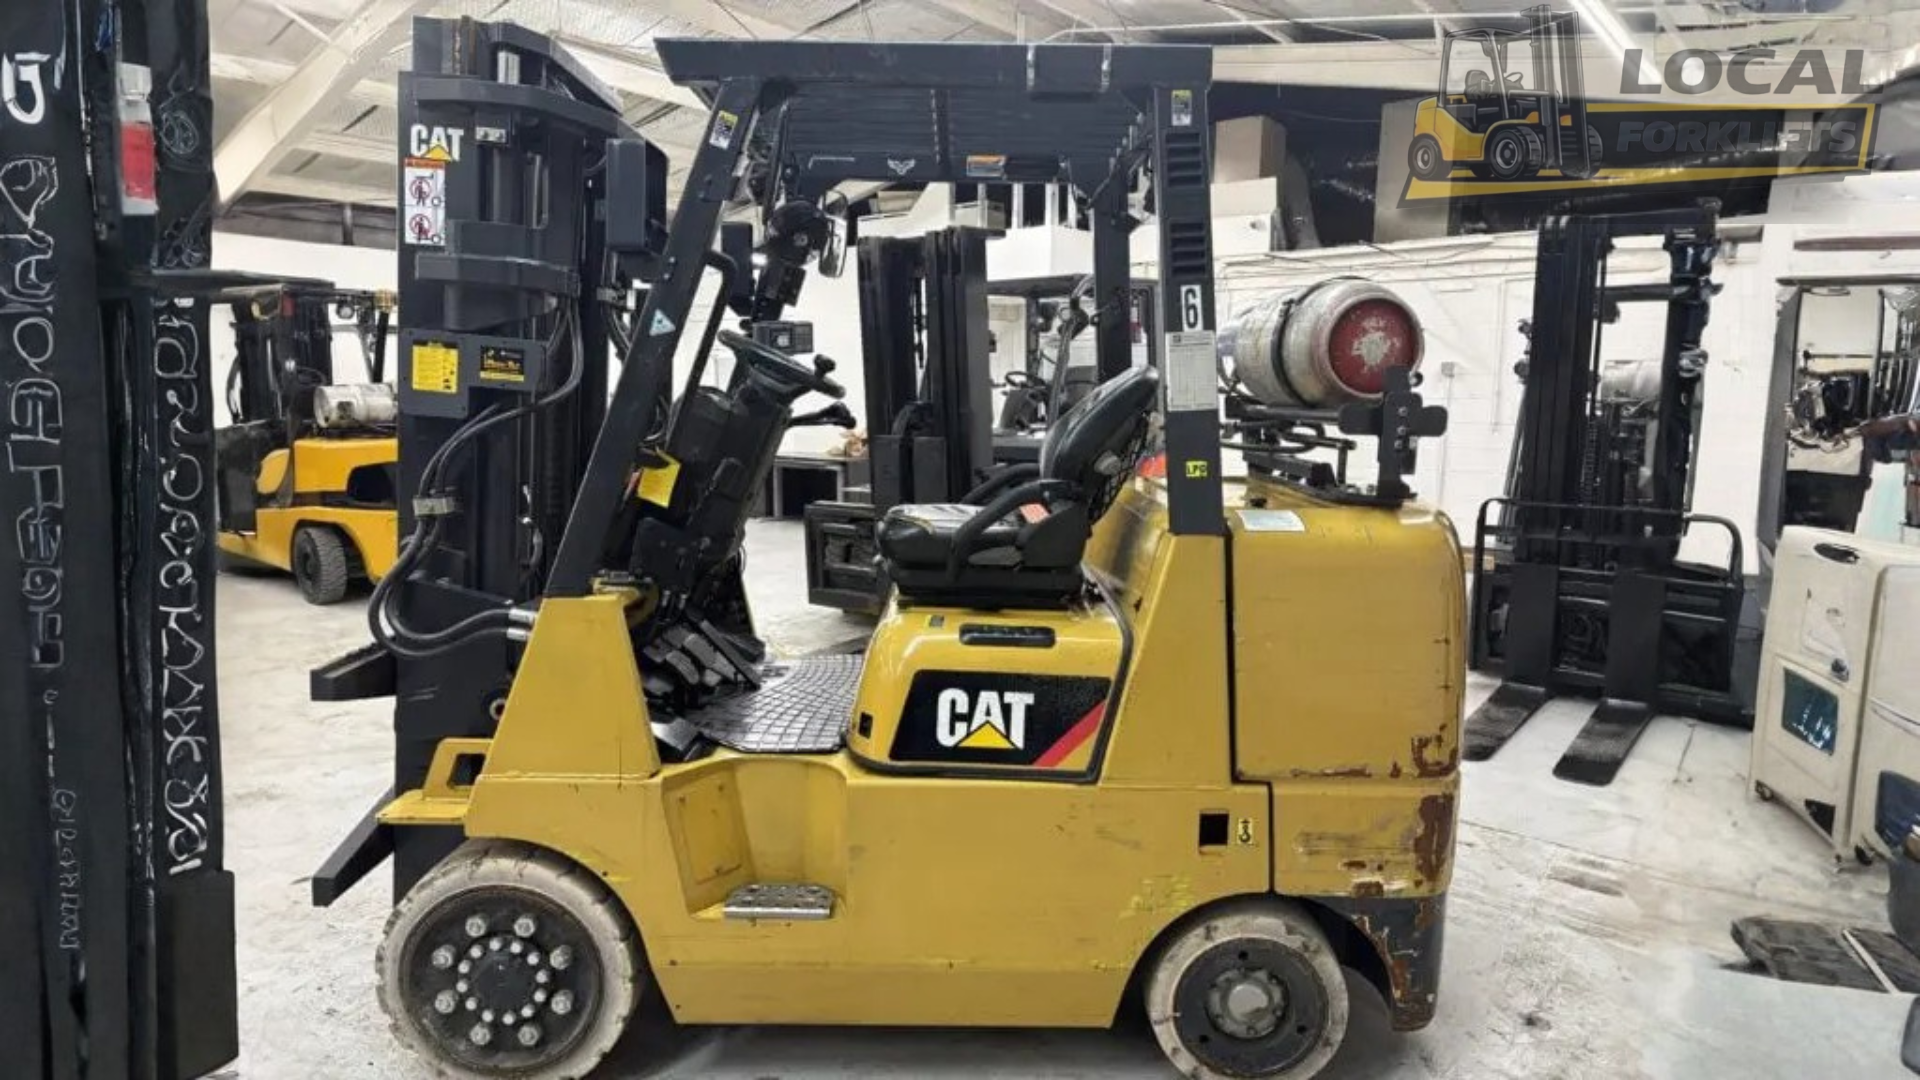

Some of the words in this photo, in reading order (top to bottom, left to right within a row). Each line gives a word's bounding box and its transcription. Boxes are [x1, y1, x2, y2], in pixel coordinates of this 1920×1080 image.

[410, 123, 464, 162] CAT
[1183, 287, 1199, 330] 6
[936, 687, 1035, 750] CAT
